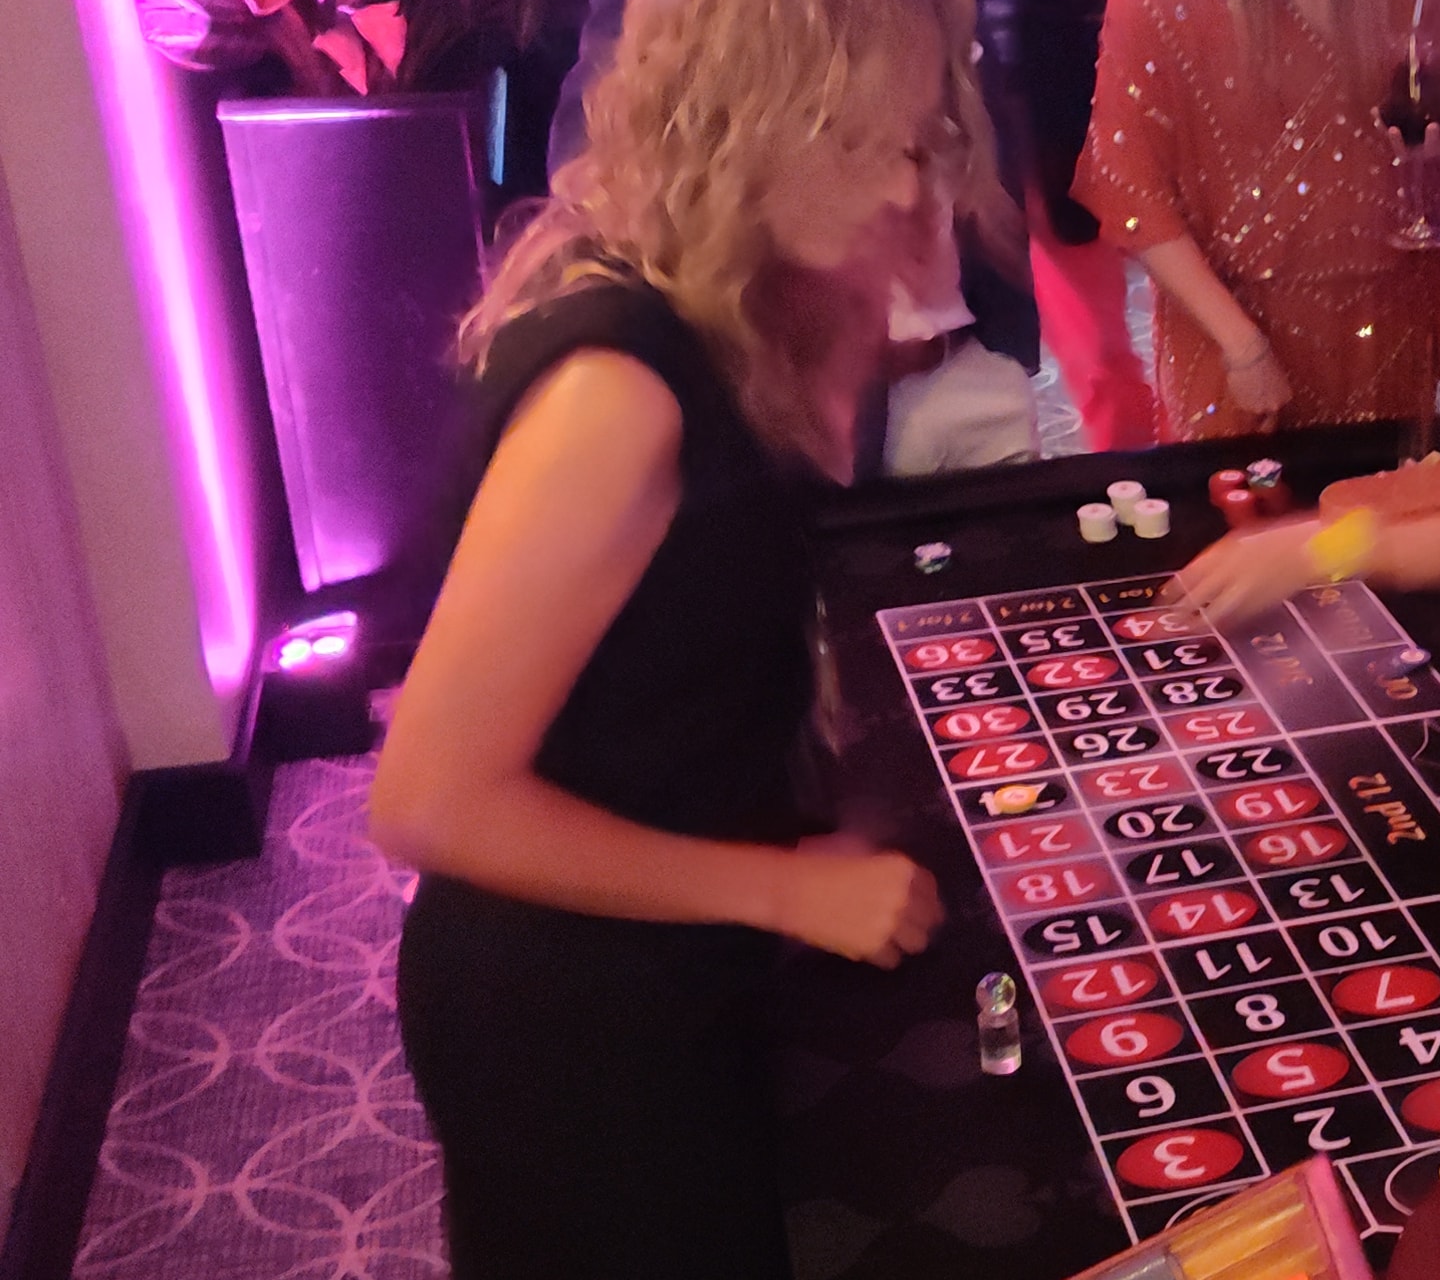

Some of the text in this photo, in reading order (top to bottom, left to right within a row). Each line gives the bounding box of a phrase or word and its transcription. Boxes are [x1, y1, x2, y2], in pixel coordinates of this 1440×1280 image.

[1020, 625, 1085, 653] 35
[1124, 611, 1190, 637] 34
[916, 639, 983, 666] 36
[1143, 644, 1207, 670] 31
[931, 672, 998, 700] 33
[1036, 657, 1104, 684] 32
[1058, 690, 1126, 720] 29
[1163, 677, 1233, 704] 28
[946, 707, 1016, 736] 30
[1186, 711, 1258, 739] 25
[967, 743, 1033, 775] 27
[1074, 728, 1146, 758] 26
[1208, 747, 1282, 778] 22
[1098, 766, 1168, 795] 23
[1235, 788, 1305, 820] 19
[1348, 772, 1426, 845] 2nd 12
[1119, 805, 1193, 838] 20
[1000, 824, 1072, 858] 21
[1259, 830, 1332, 863] 16
[1146, 849, 1215, 885] 17
[1017, 870, 1096, 903] 18
[1290, 874, 1364, 908] 13
[1168, 895, 1247, 931] 14
[1042, 916, 1122, 953] 15
[1319, 921, 1396, 957] 10
[1196, 942, 1272, 981] 11
[1062, 965, 1147, 1002] 12
[1375, 971, 1415, 1009] 7
[1236, 994, 1285, 1031] 8
[1101, 1020, 1148, 1056] 9
[1266, 1049, 1317, 1090] 5
[1126, 1076, 1176, 1117] 6
[1294, 1107, 1350, 1150] 2
[1152, 1137, 1205, 1180] 3
